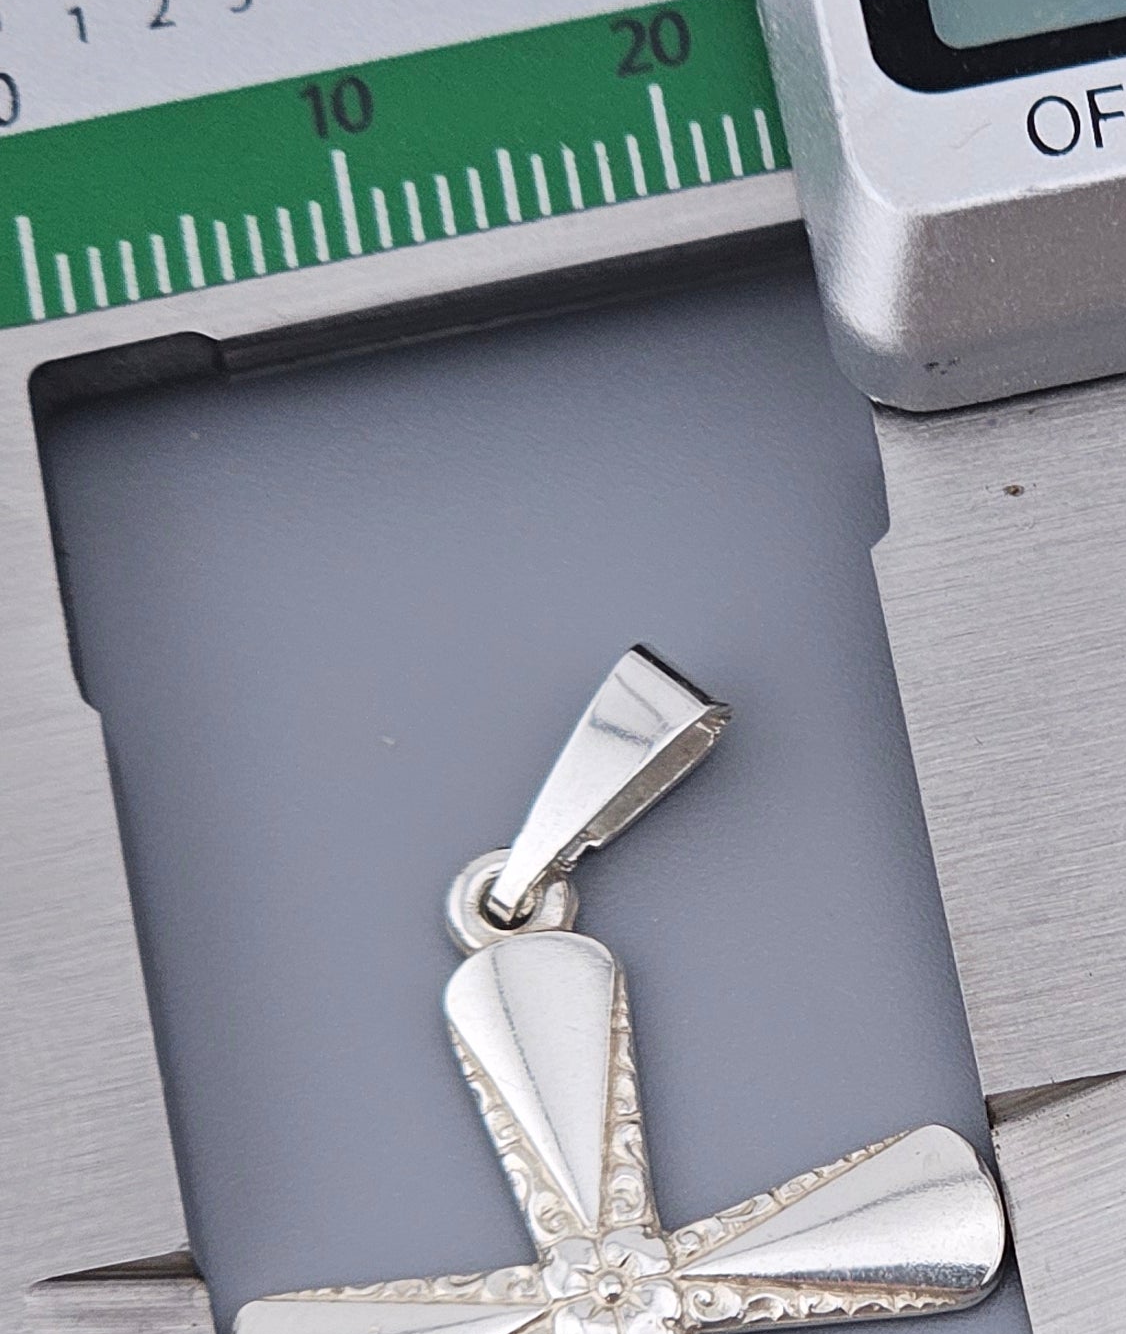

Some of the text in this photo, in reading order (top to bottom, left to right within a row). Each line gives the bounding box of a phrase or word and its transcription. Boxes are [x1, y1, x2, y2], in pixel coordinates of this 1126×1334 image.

[67, 6, 89, 44] 1
[300, 75, 375, 141] 10
[608, 9, 692, 79] 20
